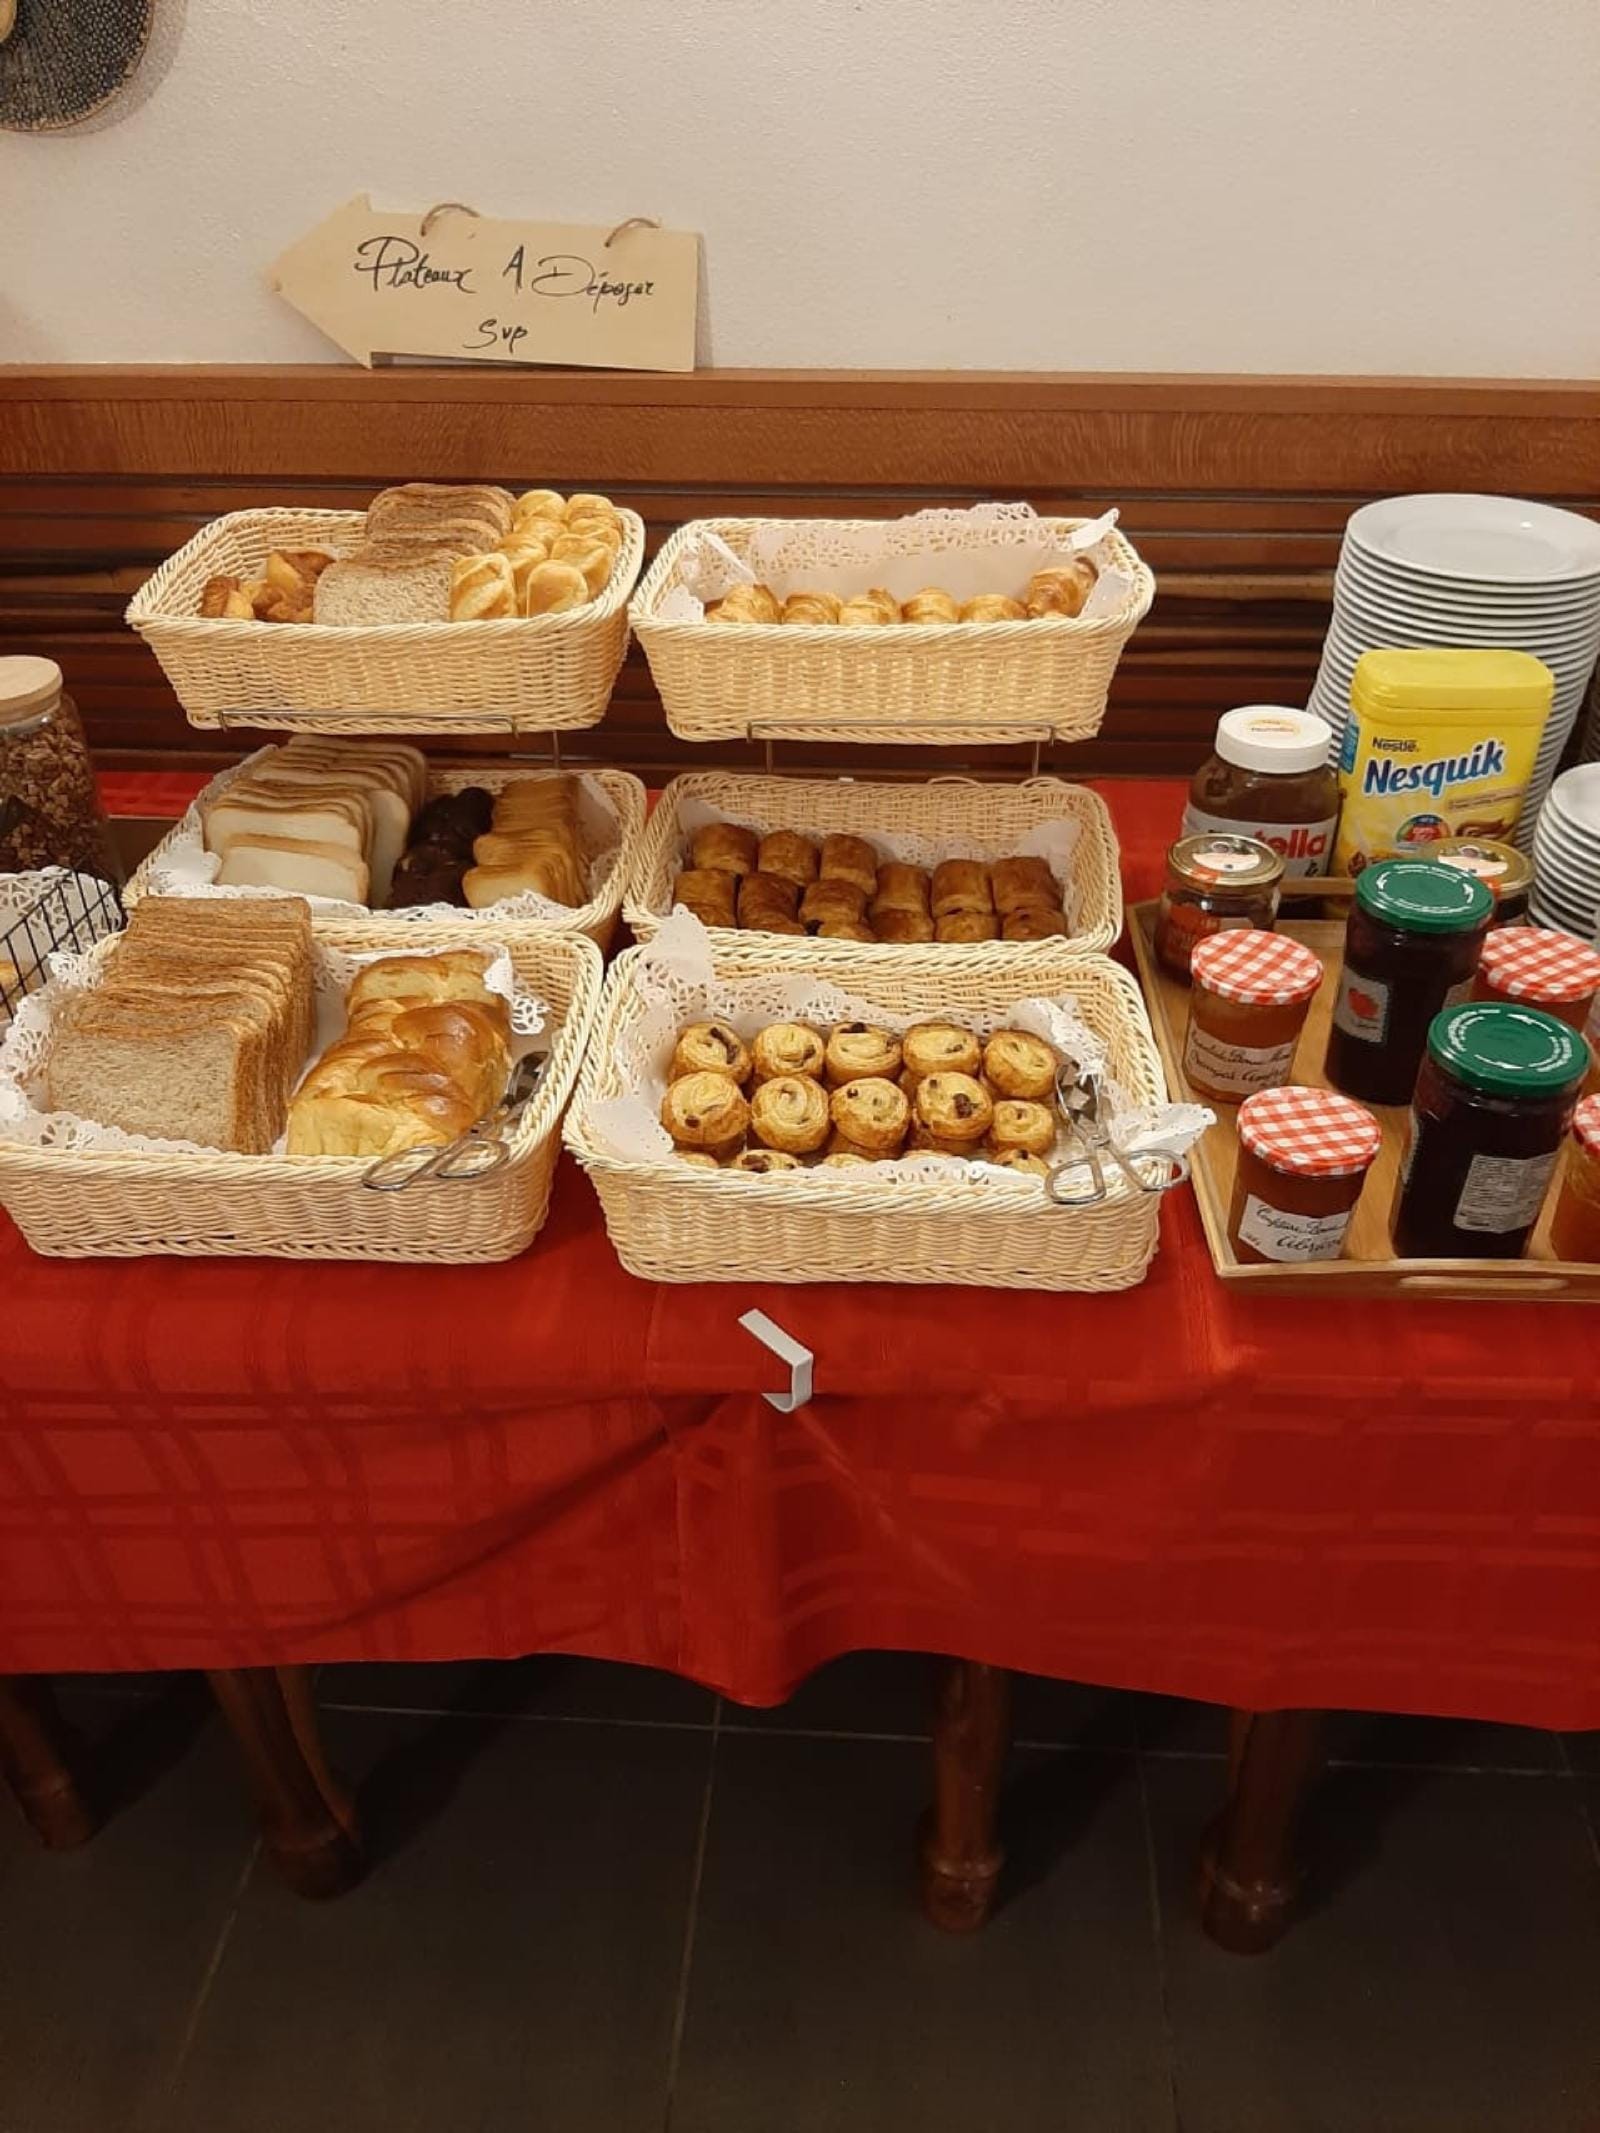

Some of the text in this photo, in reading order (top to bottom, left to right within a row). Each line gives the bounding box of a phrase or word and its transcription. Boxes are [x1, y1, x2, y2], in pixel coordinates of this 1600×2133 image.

[354, 236, 477, 294] Plateaux
[502, 245, 525, 289] A
[1363, 740, 1505, 797] Nesquik
[1254, 828, 1328, 859] ella
